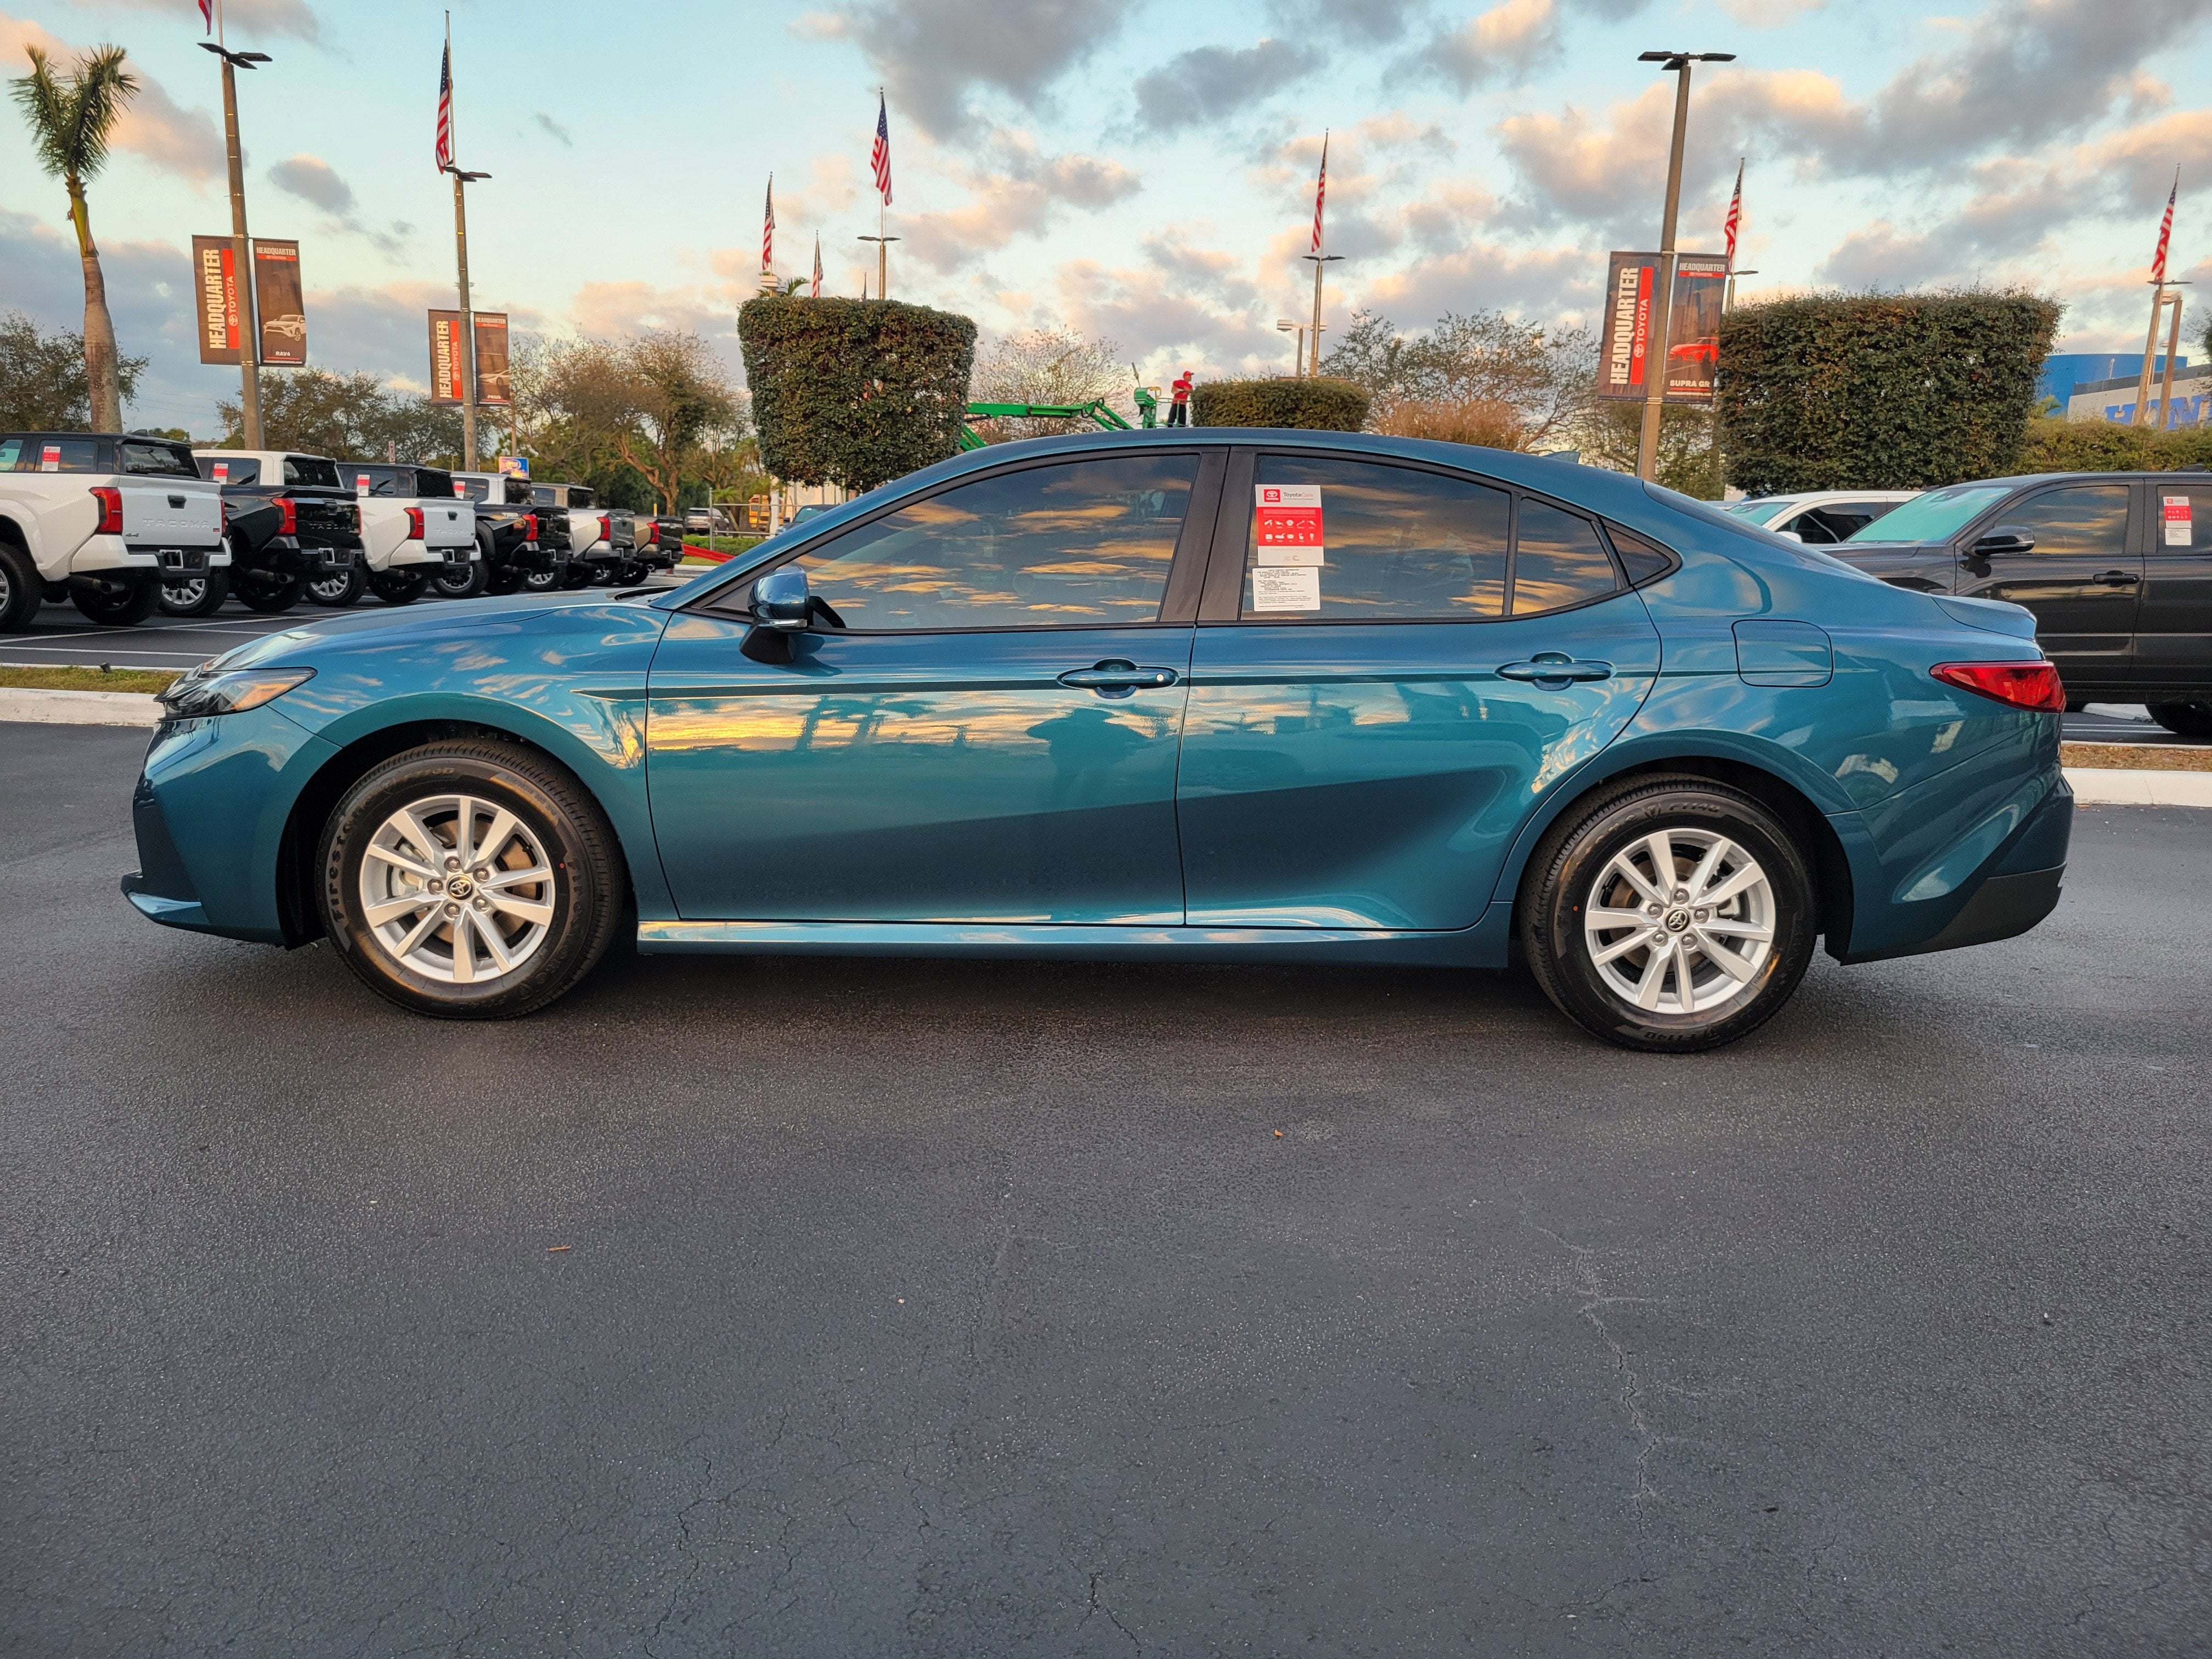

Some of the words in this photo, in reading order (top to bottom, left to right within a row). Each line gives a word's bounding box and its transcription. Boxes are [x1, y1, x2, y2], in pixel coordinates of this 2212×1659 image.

[256, 246, 296, 256] HEADQUARTER
[1679, 262, 1726, 272] HEADQUARTER
[202, 249, 227, 349] HEADQUARTER
[227, 276, 237, 314] TOYOTA
[1610, 267, 1639, 385] HEADQUARTER
[1636, 299, 1649, 343] TOYOTA
[436, 320, 453, 398] HEADQUARTER
[142, 518, 210, 528] TACOMA
